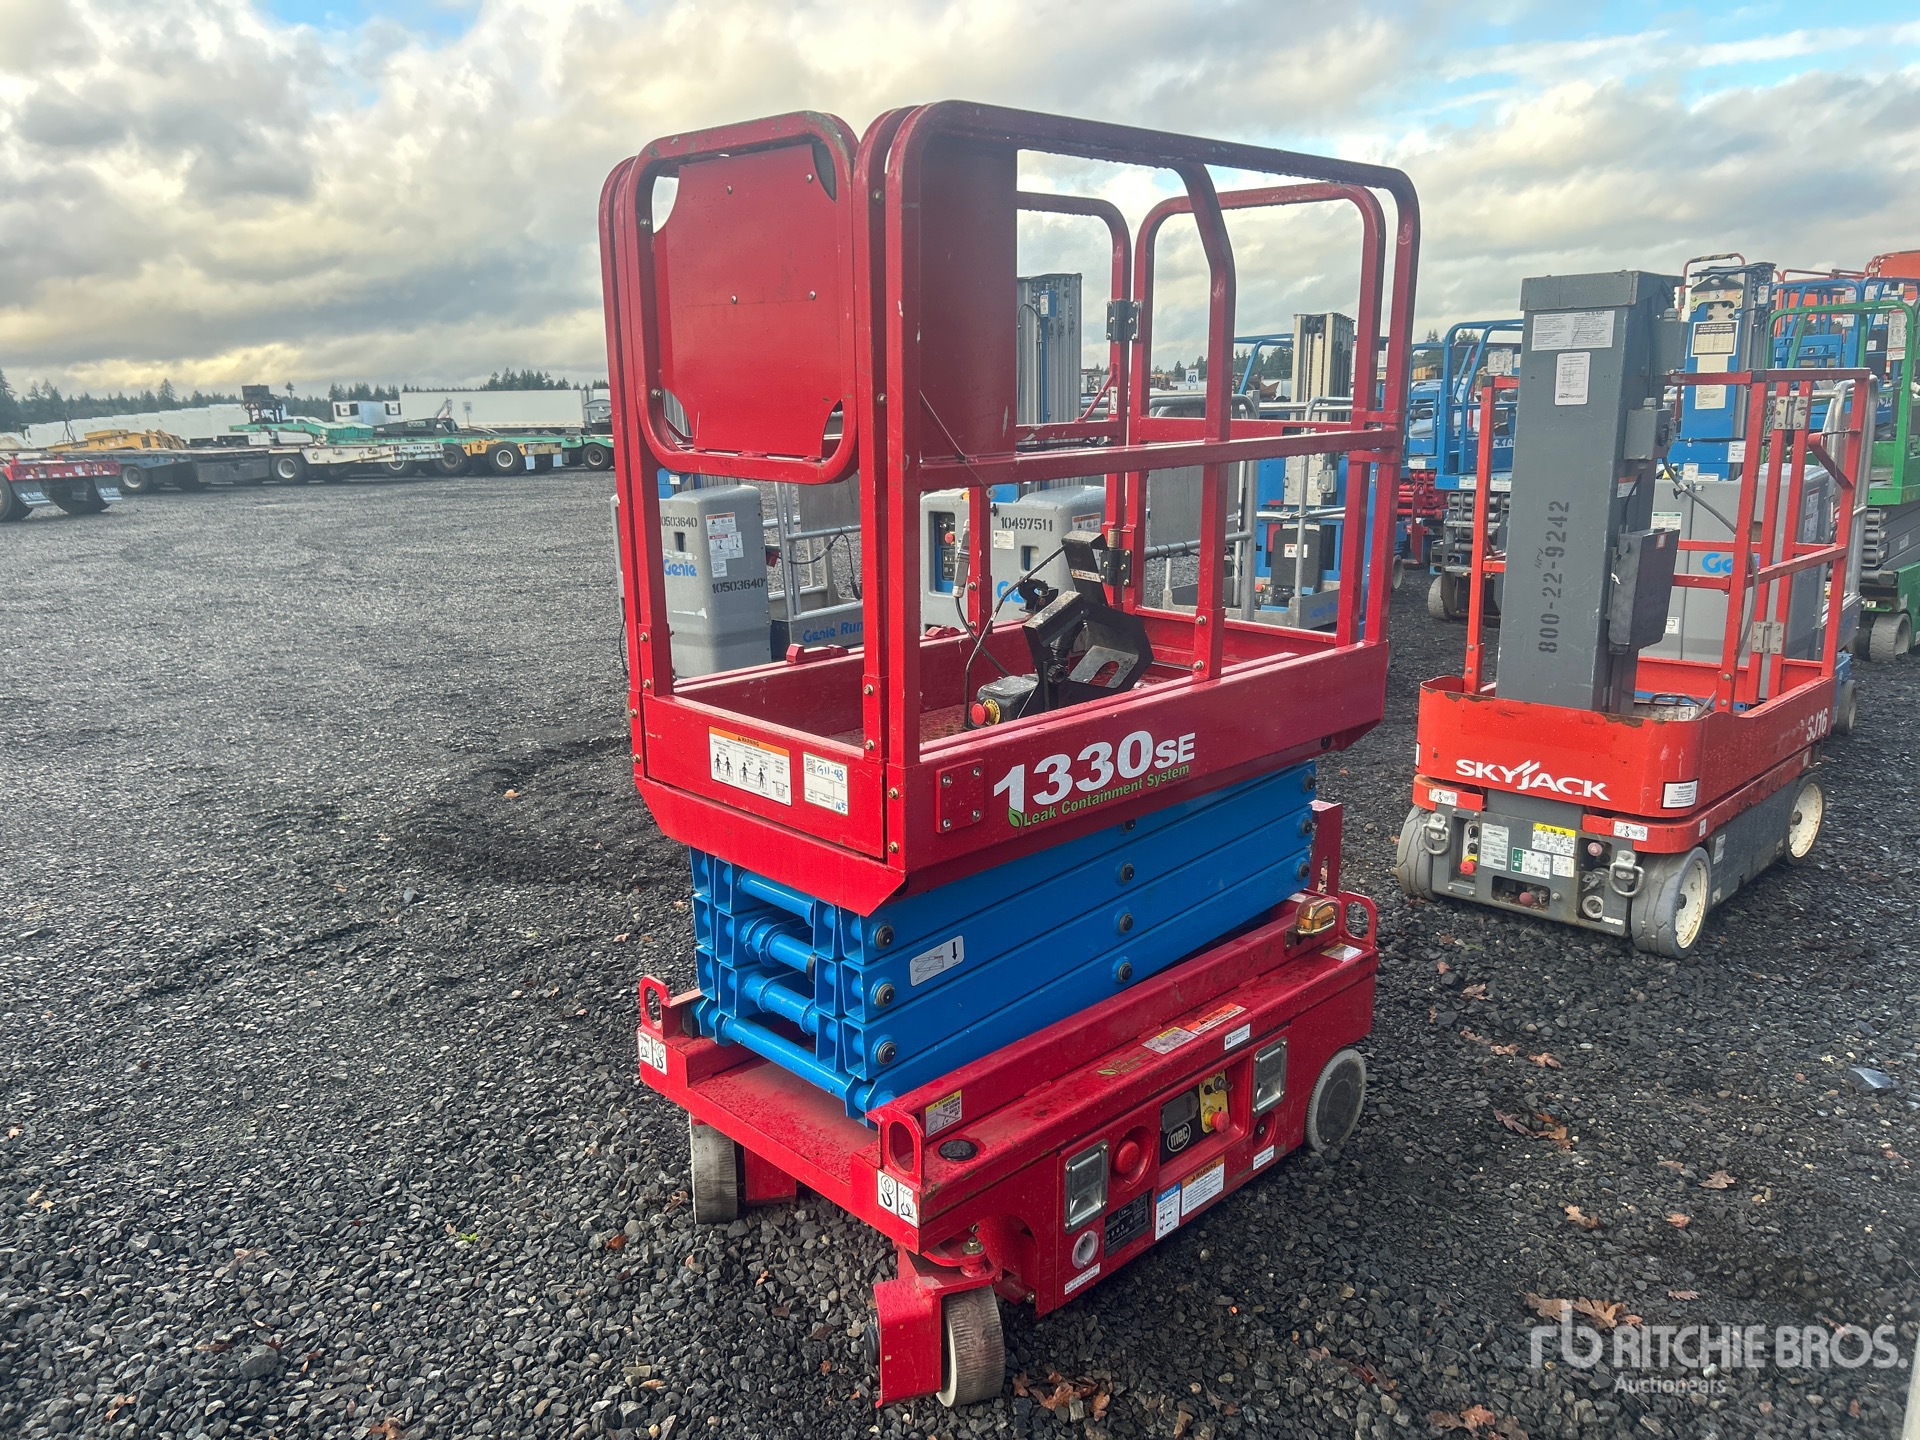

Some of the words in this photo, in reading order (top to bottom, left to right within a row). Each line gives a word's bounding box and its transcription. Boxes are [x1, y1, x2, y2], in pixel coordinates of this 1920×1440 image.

[1187, 374, 1197, 383] 40
[661, 516, 698, 528] 0503640
[1000, 516, 1053, 532] 10497511
[663, 558, 697, 577] Genie
[1538, 500, 1570, 654] 800-22-9242
[711, 578, 765, 594] 10503640
[802, 626, 836, 643] Genie
[741, 736, 760, 747] WARNING
[1455, 758, 1610, 801] SKYJACK
[1024, 805, 1057, 827] Leak
[1061, 777, 1143, 816] Containment
[1147, 764, 1190, 787] System
[1195, 1161, 1217, 1180] WARNING
[1161, 1184, 1177, 1200] NOTICE
